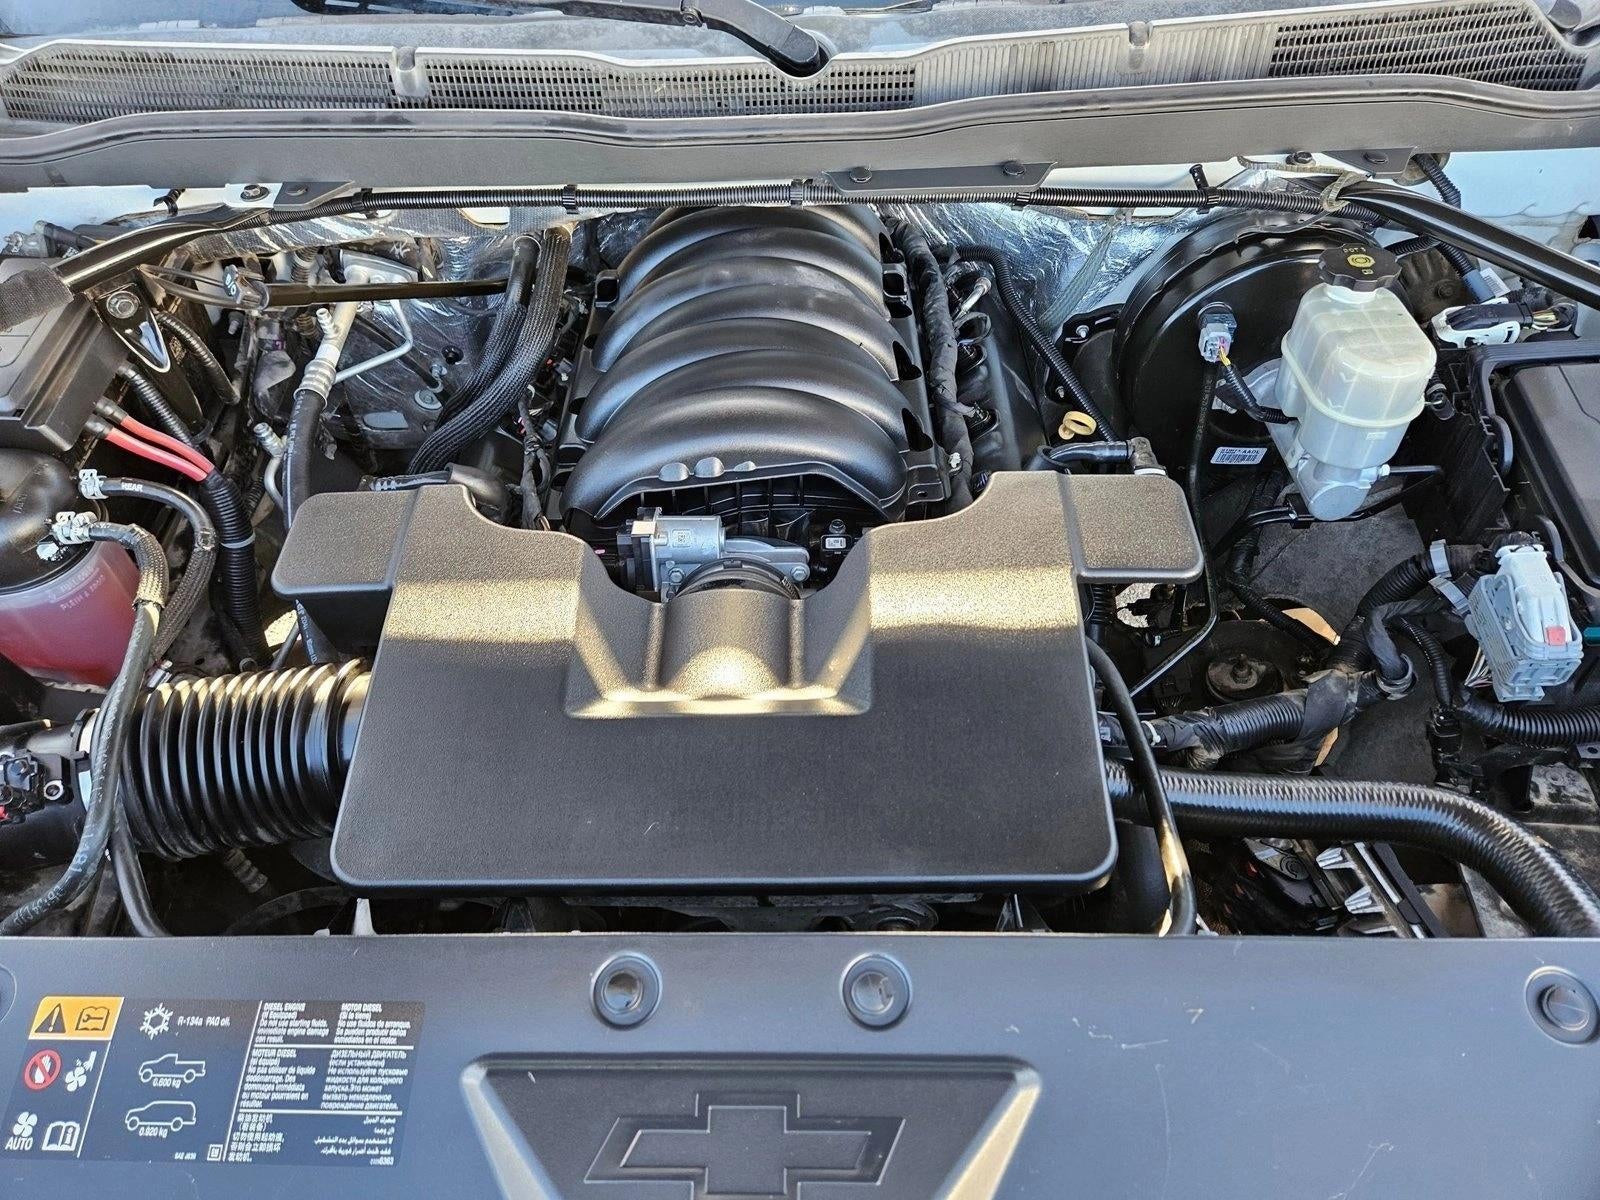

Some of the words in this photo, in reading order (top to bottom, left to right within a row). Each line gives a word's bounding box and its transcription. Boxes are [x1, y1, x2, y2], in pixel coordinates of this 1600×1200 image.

[172, 1078, 181, 1089] kg
[159, 1126, 168, 1138] kg
[5, 1136, 33, 1151] AUTO
